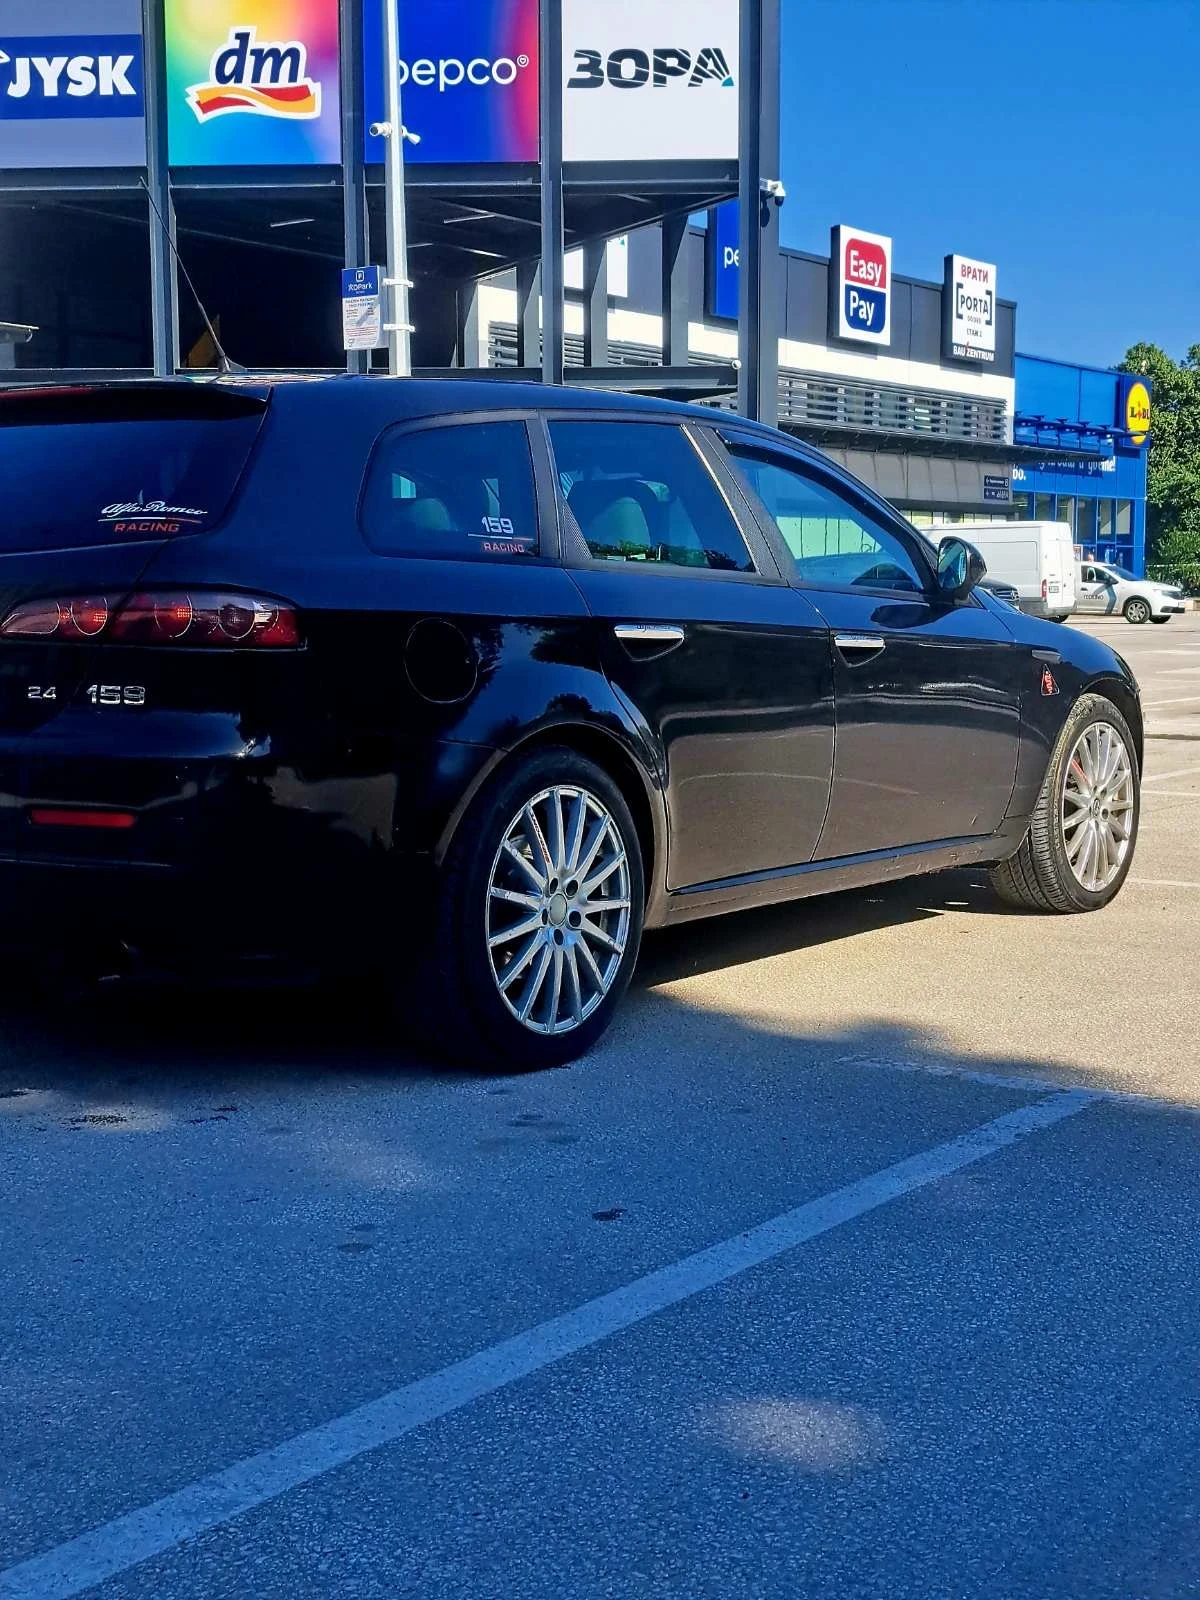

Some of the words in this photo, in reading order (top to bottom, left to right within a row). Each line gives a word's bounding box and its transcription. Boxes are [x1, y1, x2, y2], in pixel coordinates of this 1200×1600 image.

[215, 31, 301, 85] dm
[567, 47, 734, 89] ЗОРА
[7, 55, 137, 98] JYSK
[850, 249, 883, 287] Easy
[960, 264, 989, 284] ВРАТИ
[850, 290, 875, 327] Pay
[960, 294, 989, 315] PORTA
[101, 502, 143, 518] Alfa
[143, 501, 208, 515] Romeo
[115, 523, 180, 533] RACING
[481, 516, 514, 534] 159
[484, 542, 525, 553] RACING
[86, 684, 146, 705] 159
